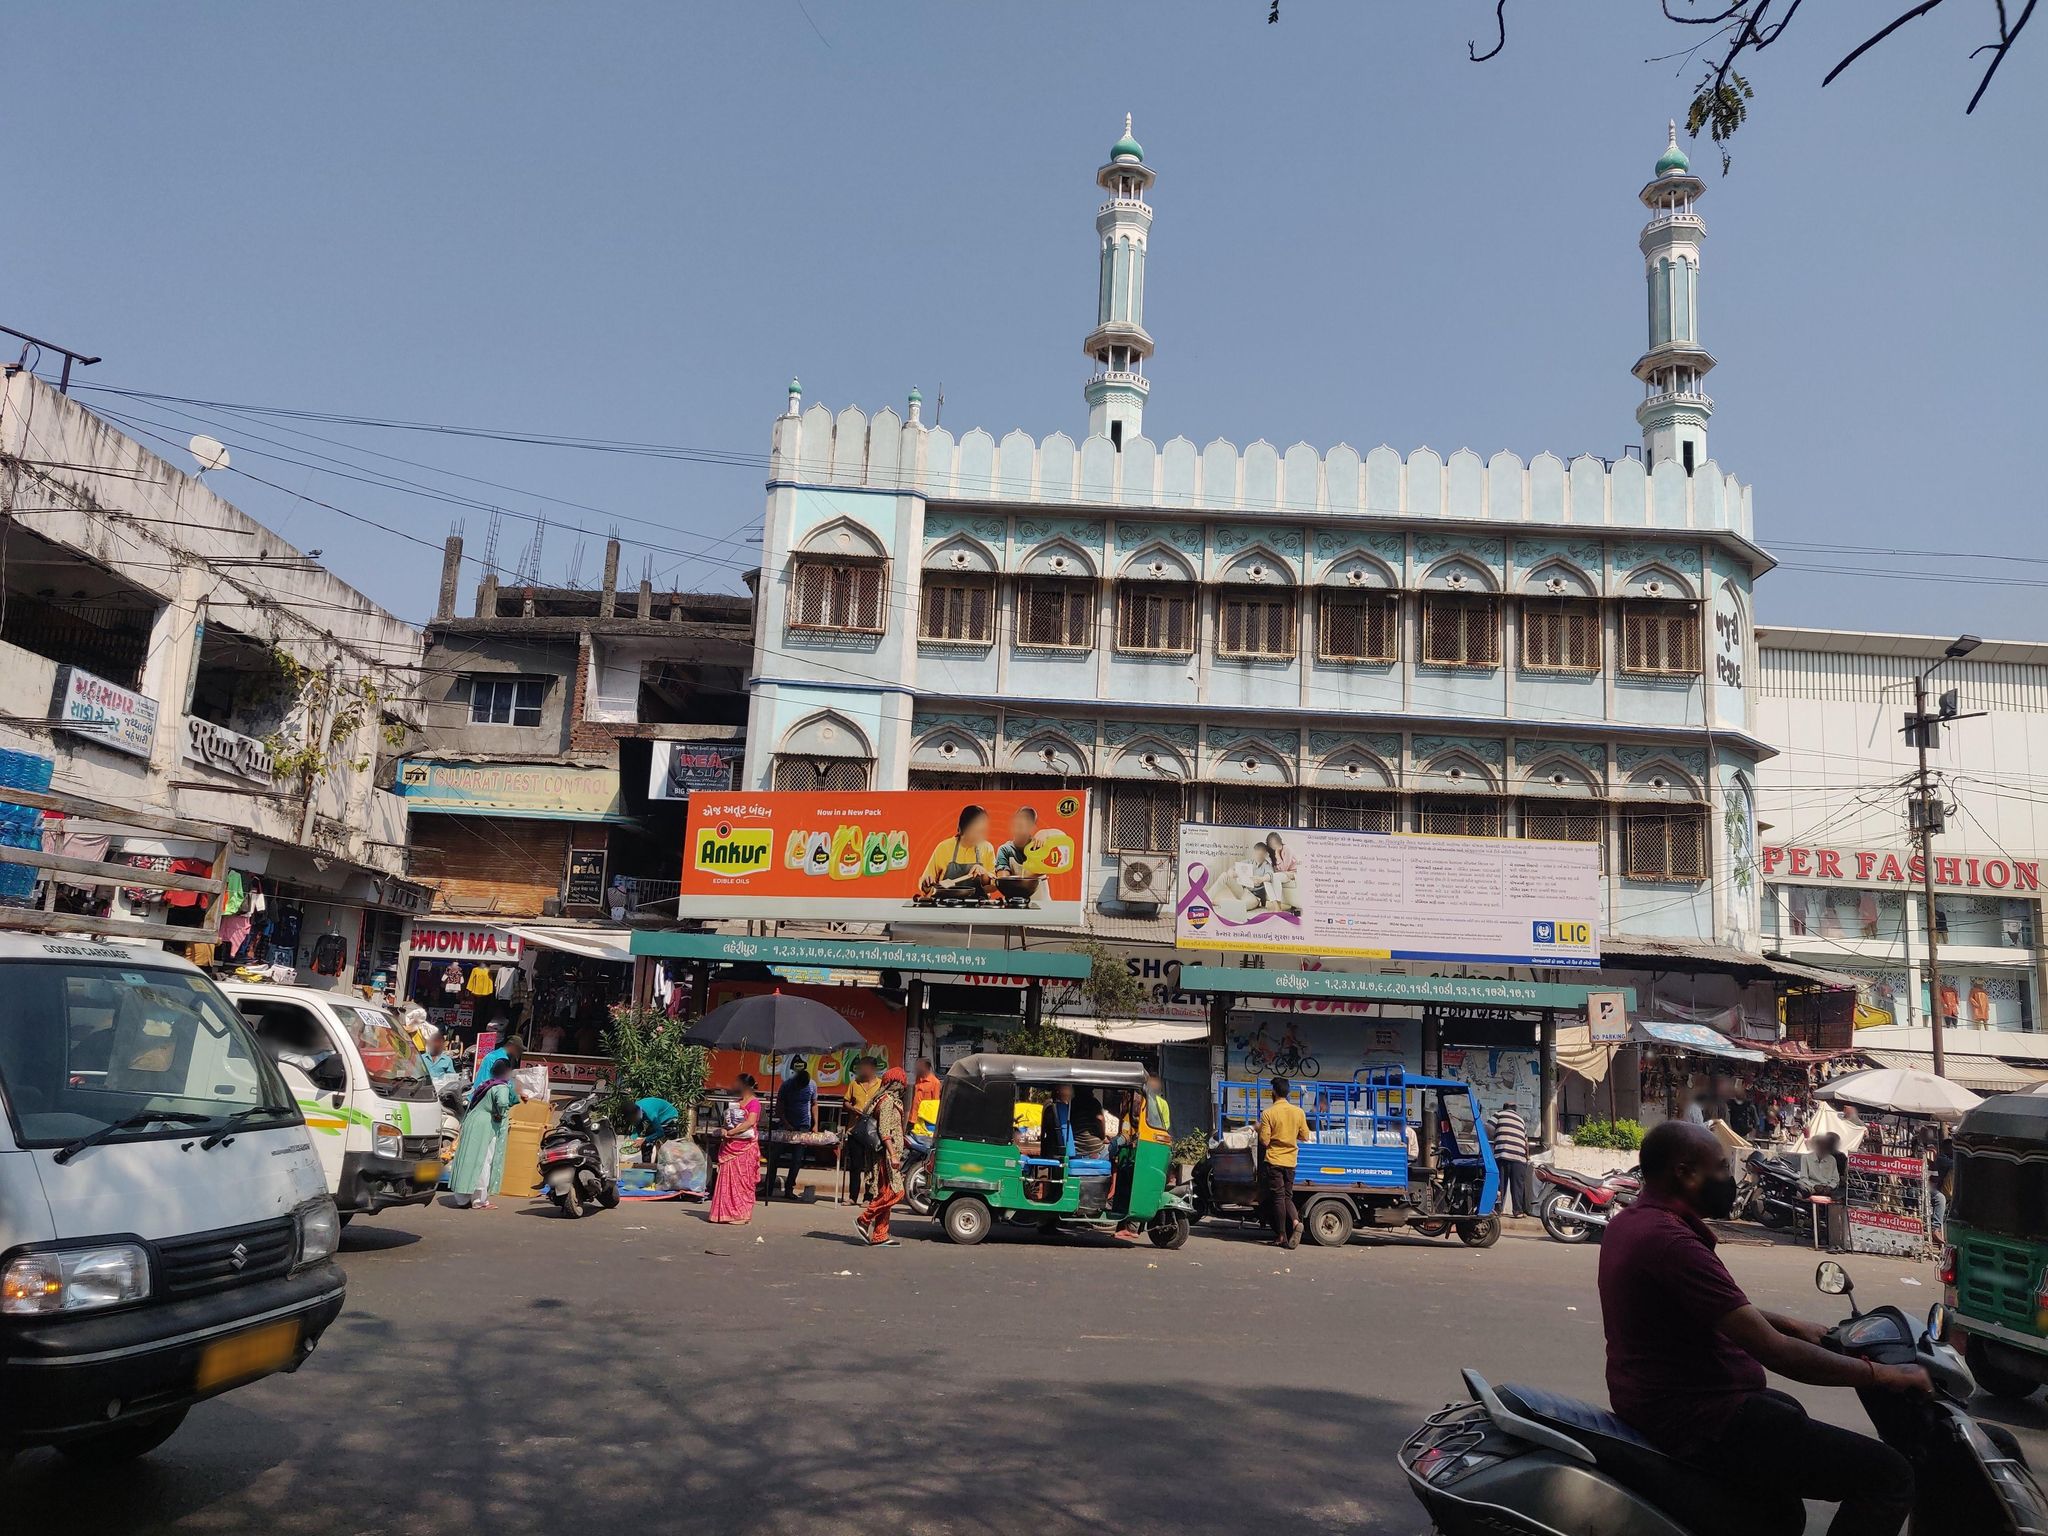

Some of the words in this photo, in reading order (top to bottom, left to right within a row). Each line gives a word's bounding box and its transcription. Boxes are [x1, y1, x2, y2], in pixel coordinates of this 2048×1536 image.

[435, 769, 499, 790] GUJARAT
[503, 771, 539, 792] PEST
[544, 776, 609, 795] CONTROL
[747, 805, 772, 817] બંધન
[1061, 801, 1075, 814] 40
[701, 841, 767, 864] Ankur
[573, 864, 600, 874] REAL
[1762, 847, 1844, 879] PER
[1856, 851, 2040, 890] FASHION
[1559, 924, 1586, 942] LIC
[43, 944, 82, 955] GOODS
[82, 947, 132, 959] CARRIAGE
[722, 940, 757, 957] લહેરીપુરા
[1276, 974, 1309, 990] લહેરીપુરા
[1880, 1160, 1923, 1172] ચાવીવાલા
[1880, 1216, 1920, 1230] ચાવીવાલા
